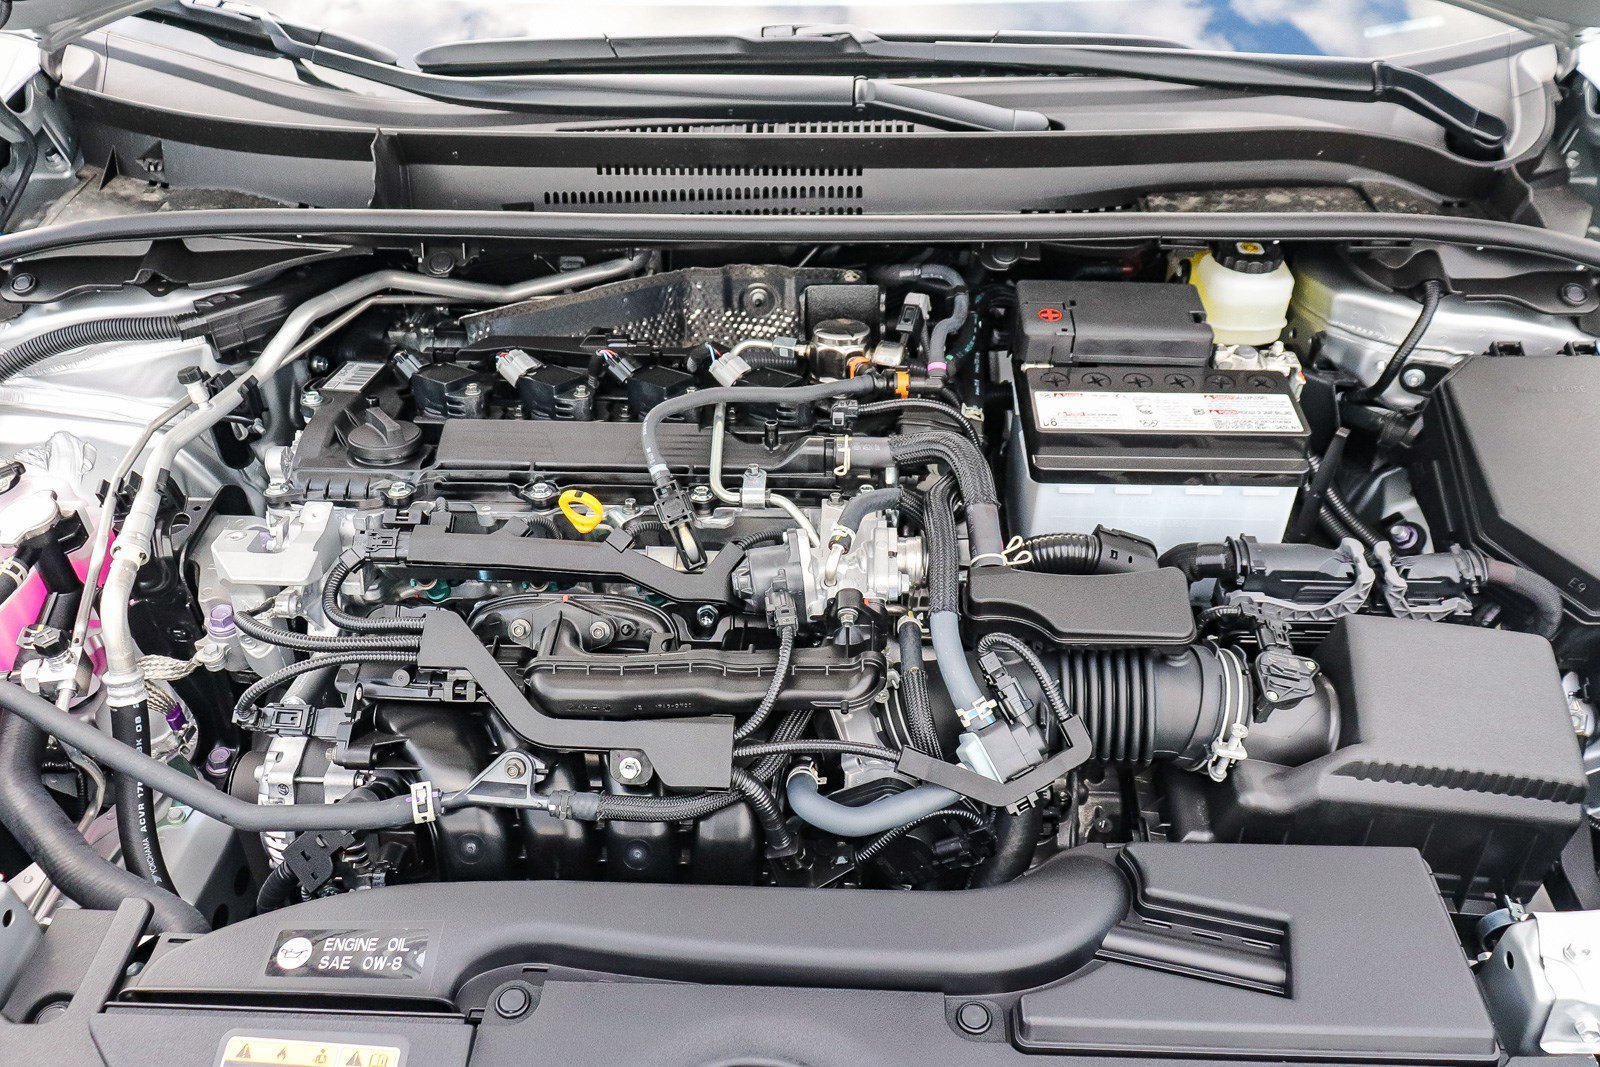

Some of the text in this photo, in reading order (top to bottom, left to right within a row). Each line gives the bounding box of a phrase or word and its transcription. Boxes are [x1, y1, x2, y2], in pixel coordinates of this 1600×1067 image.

[138, 803, 148, 832] ACVR
[142, 837, 157, 875] YOKOHAMA
[324, 938, 410, 952] ENGINE OIL
[317, 955, 403, 971] SAE 0W-8
